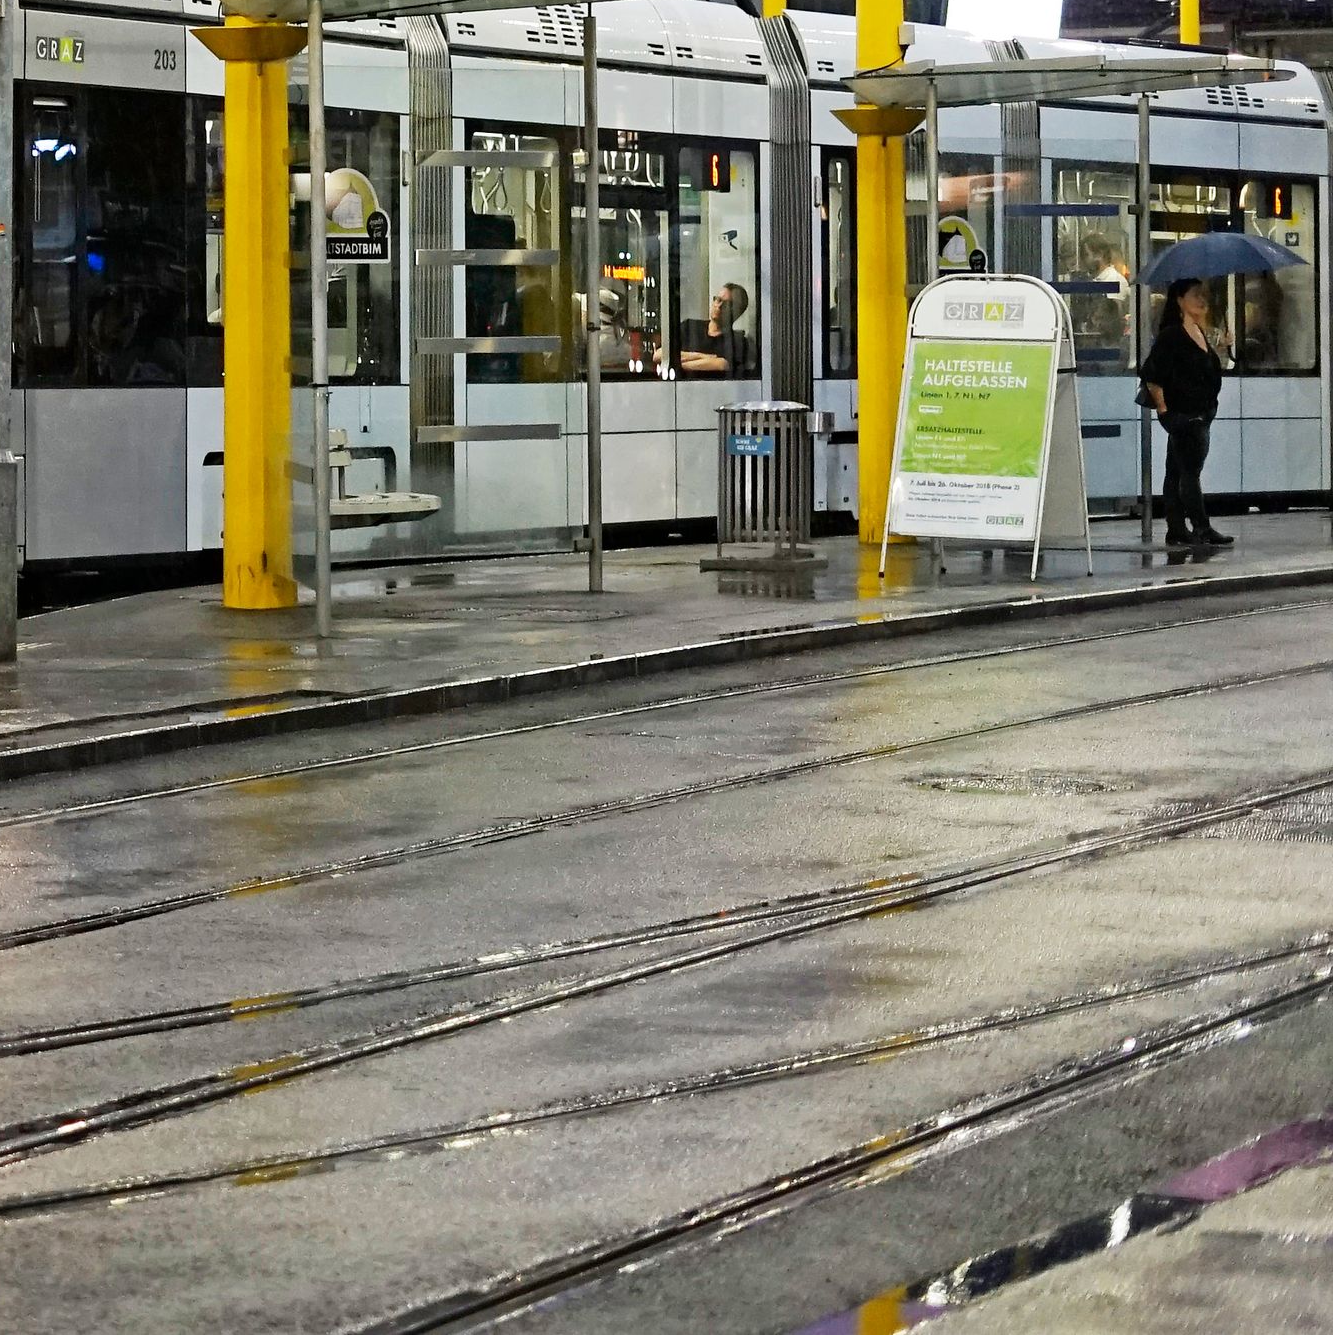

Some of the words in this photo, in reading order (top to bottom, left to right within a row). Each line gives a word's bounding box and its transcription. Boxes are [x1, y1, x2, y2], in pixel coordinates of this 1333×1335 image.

[37, 37, 85, 62] GRAZ
[154, 49, 176, 70] 203
[711, 154, 720, 187] 6
[945, 303, 1023, 320] GRAZ
[924, 359, 1013, 374] HALTESTELLE
[922, 374, 1028, 388] AUFGELASSEN
